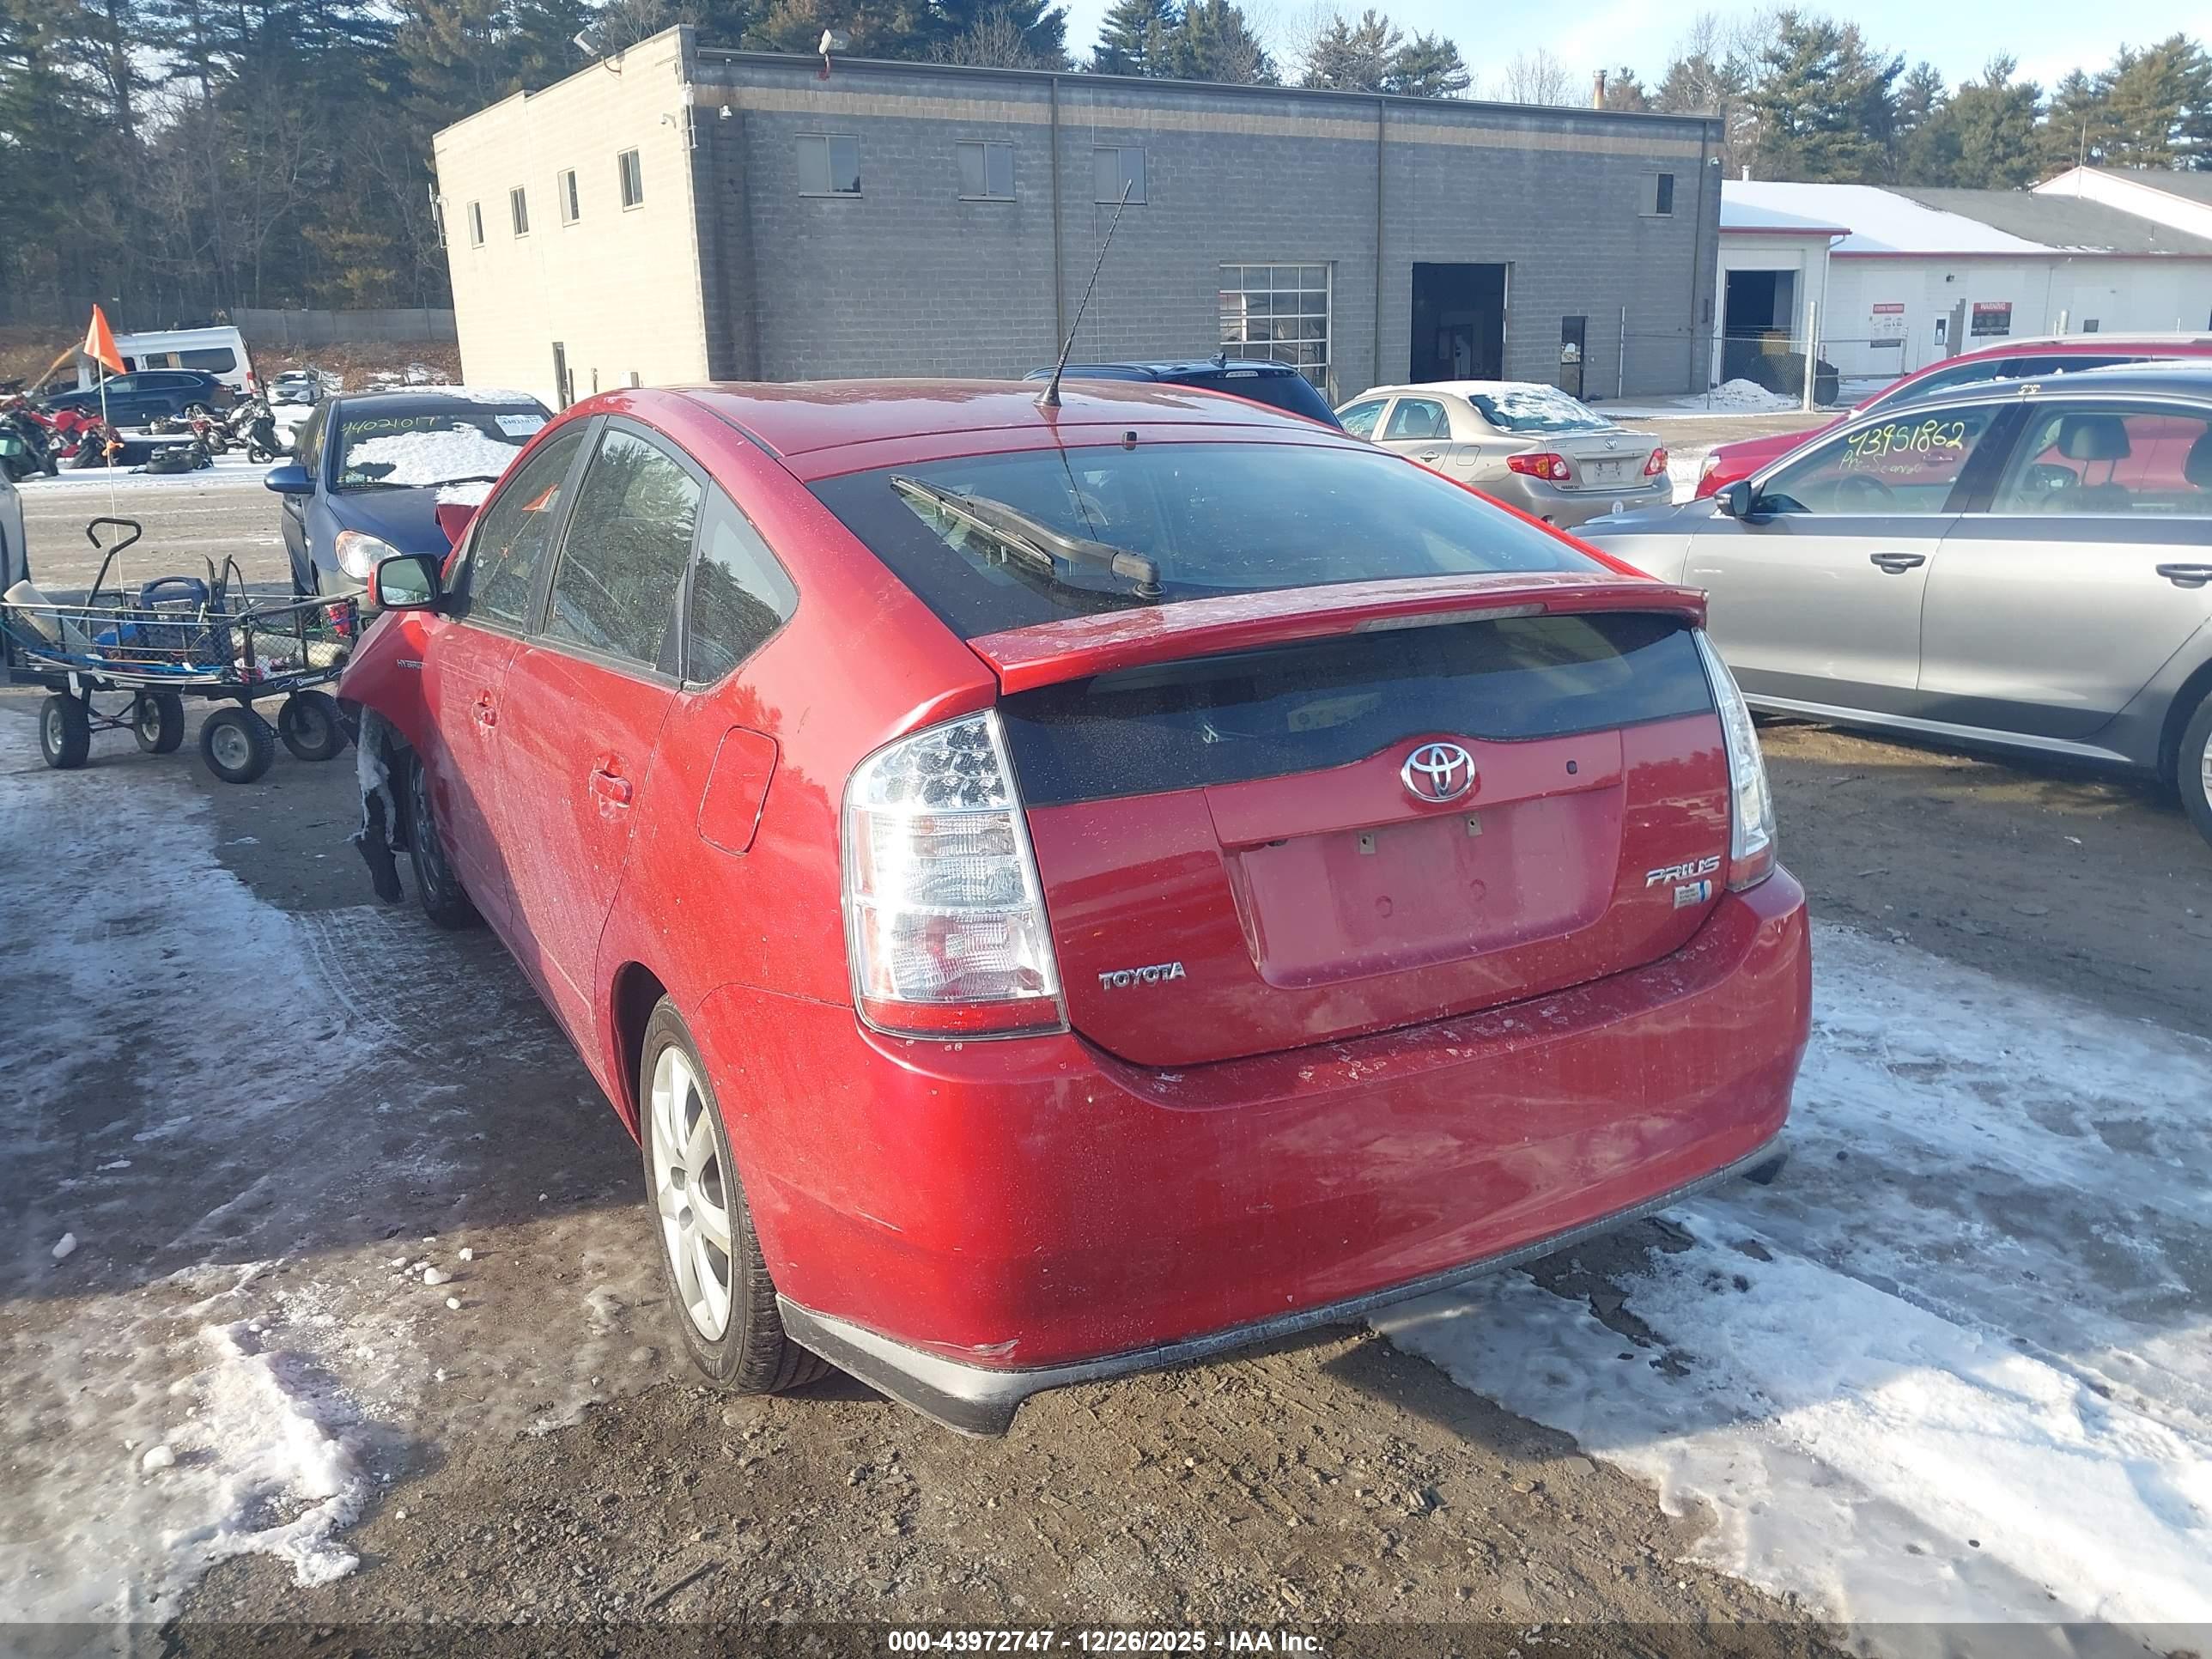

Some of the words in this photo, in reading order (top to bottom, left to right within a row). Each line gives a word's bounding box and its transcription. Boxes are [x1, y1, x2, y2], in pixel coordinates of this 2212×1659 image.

[340, 416, 435, 437] 44021017
[1644, 854, 1721, 888] PRIUS
[1098, 961, 1187, 991] TOYOTA
